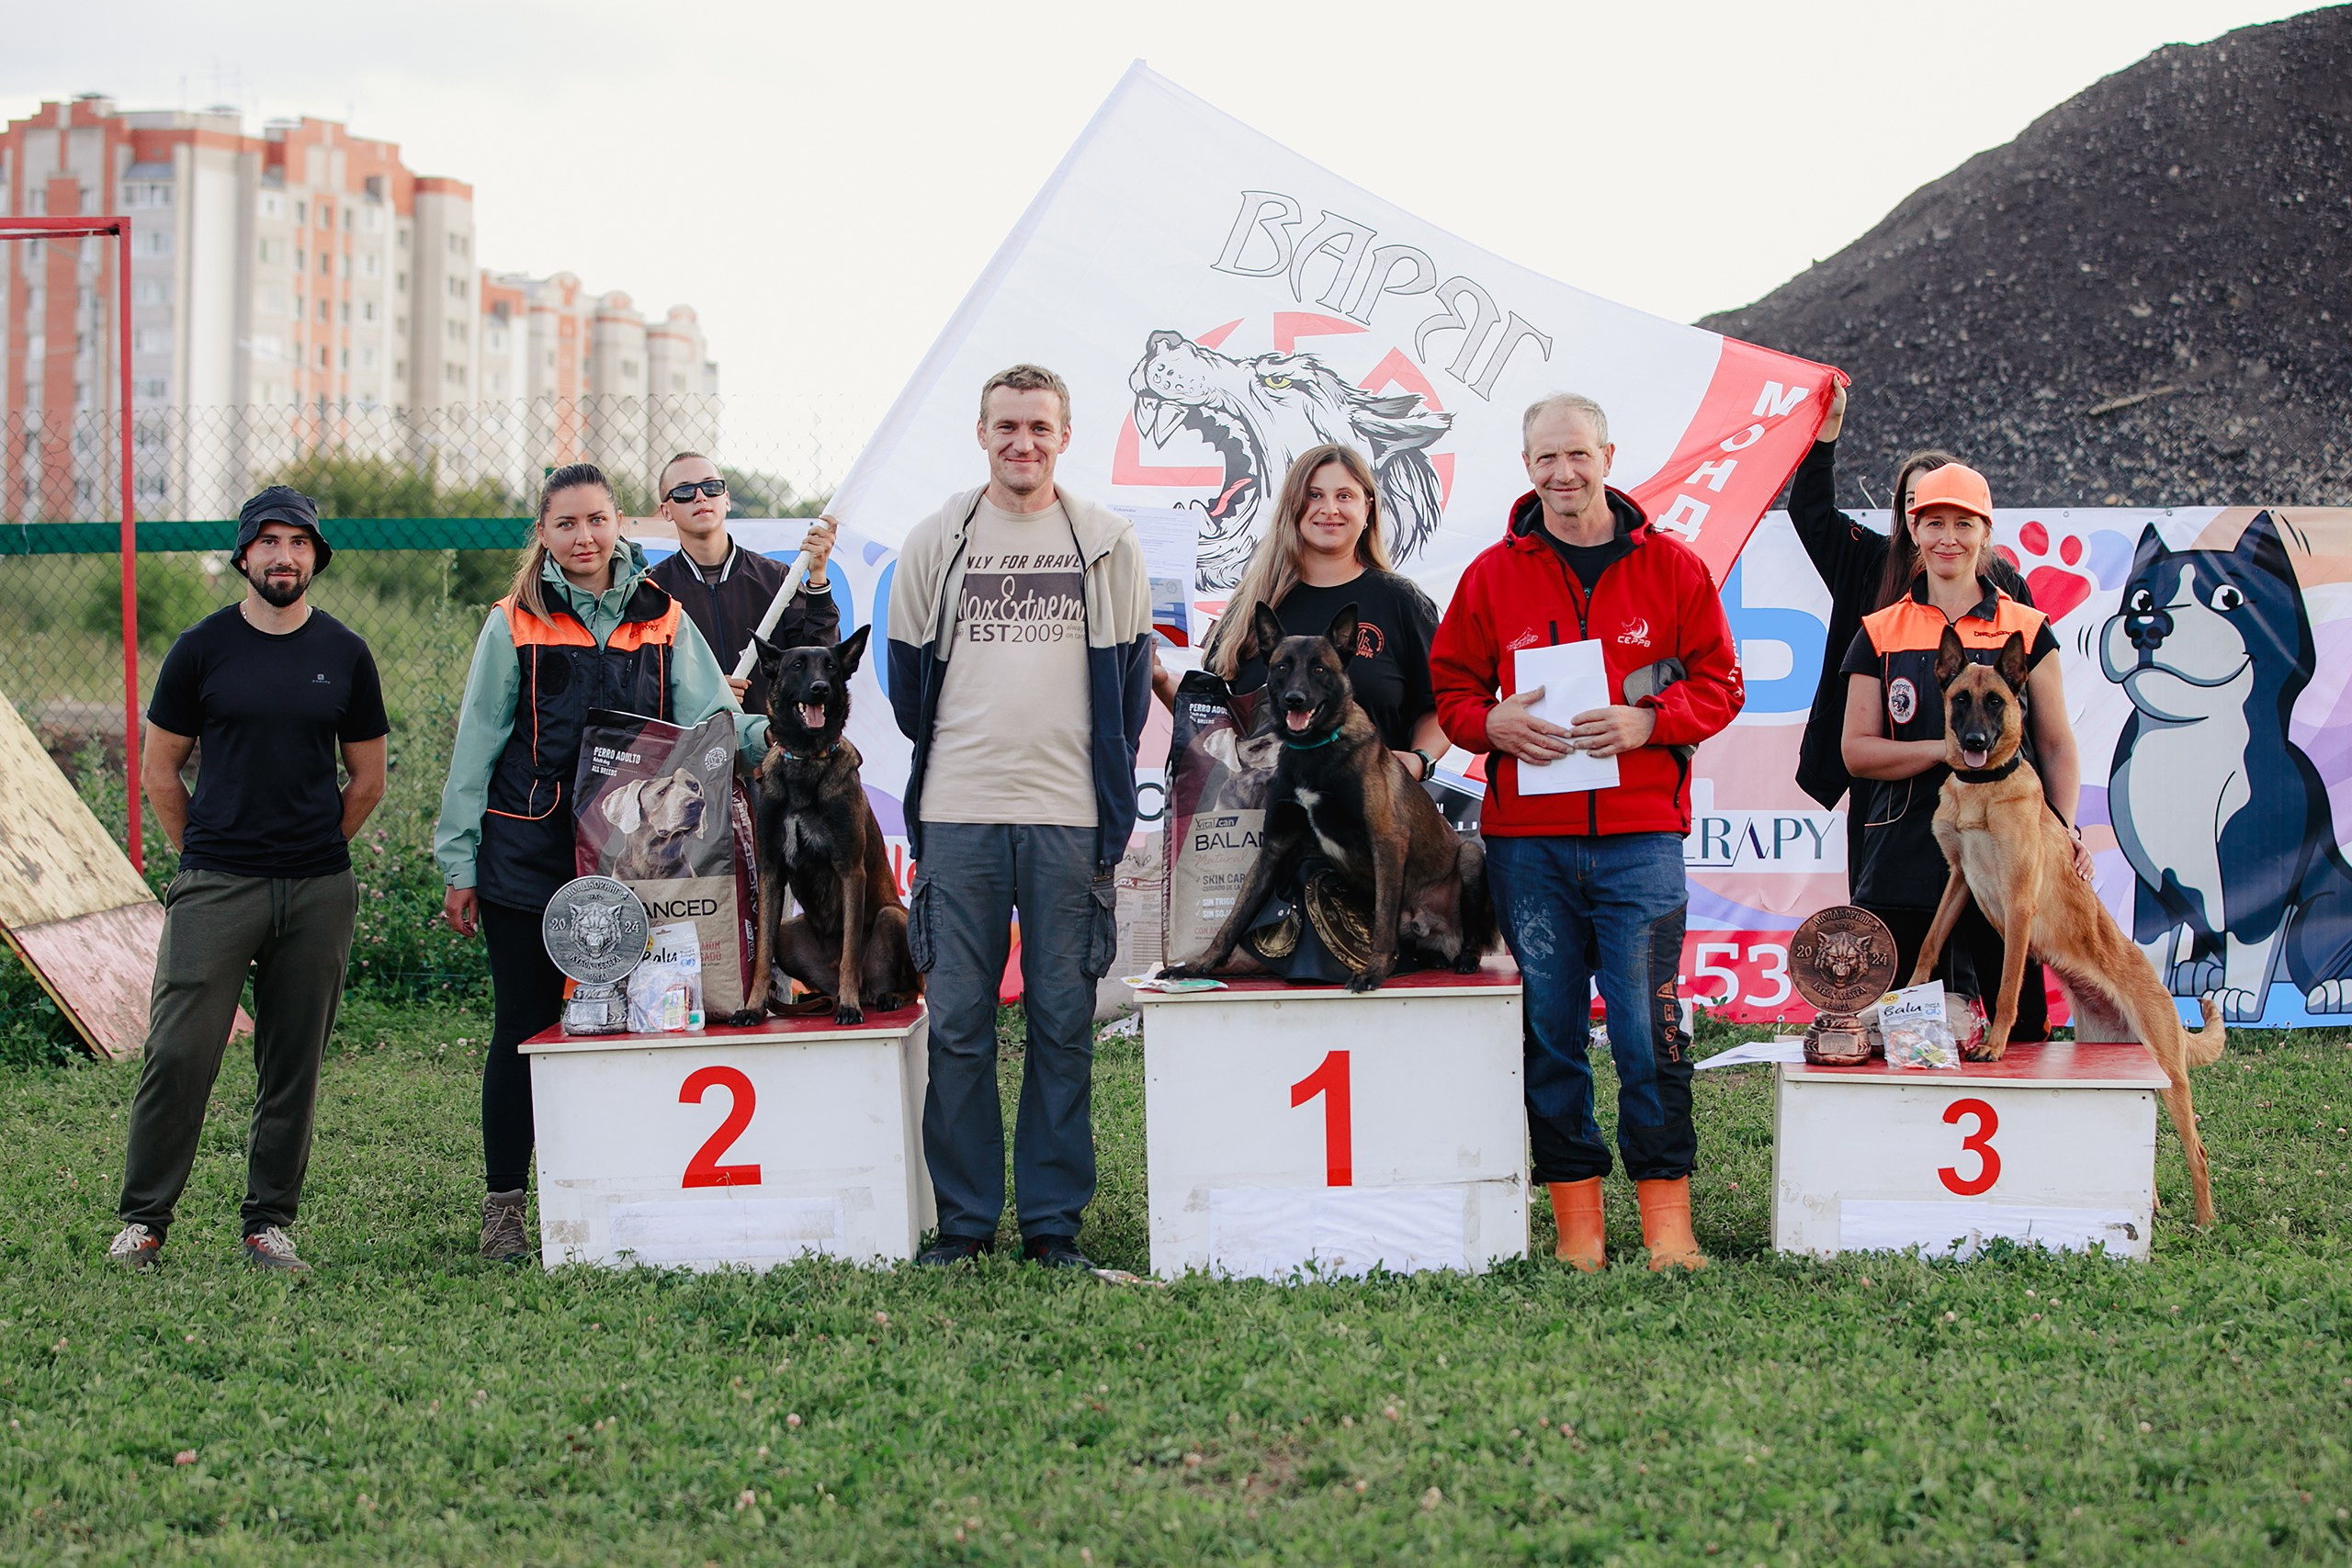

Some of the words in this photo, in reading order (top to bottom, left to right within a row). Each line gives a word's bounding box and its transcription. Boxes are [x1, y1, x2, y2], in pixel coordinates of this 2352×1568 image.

[1210, 190, 1554, 402] ВАРЯГ
[1653, 379, 1810, 544] МОНД
[967, 556, 994, 570] NLY
[1000, 555, 1029, 570] FOR
[1189, 704, 1211, 713] PERRO
[1211, 705, 1230, 715] ADUL
[593, 747, 616, 761] PERRO
[615, 750, 641, 764] ADULTO
[591, 764, 600, 773] ALL
[600, 766, 618, 777] BREEDS
[1203, 875, 1225, 886] SKIN
[1227, 874, 1246, 884] CAR
[642, 899, 718, 919] ANCED
[1203, 898, 1215, 907] SIN
[1215, 897, 1236, 906] TRIGO
[1203, 909, 1215, 918] SIN
[551, 918, 567, 931] 20
[624, 920, 640, 935] 24
[1796, 944, 1813, 958] 20
[1871, 953, 1888, 966] 24
[1883, 1002, 1922, 1018] Balu
[1291, 1050, 1352, 1187] 1
[678, 1066, 763, 1189] 2
[1938, 1098, 2001, 1196] 3
